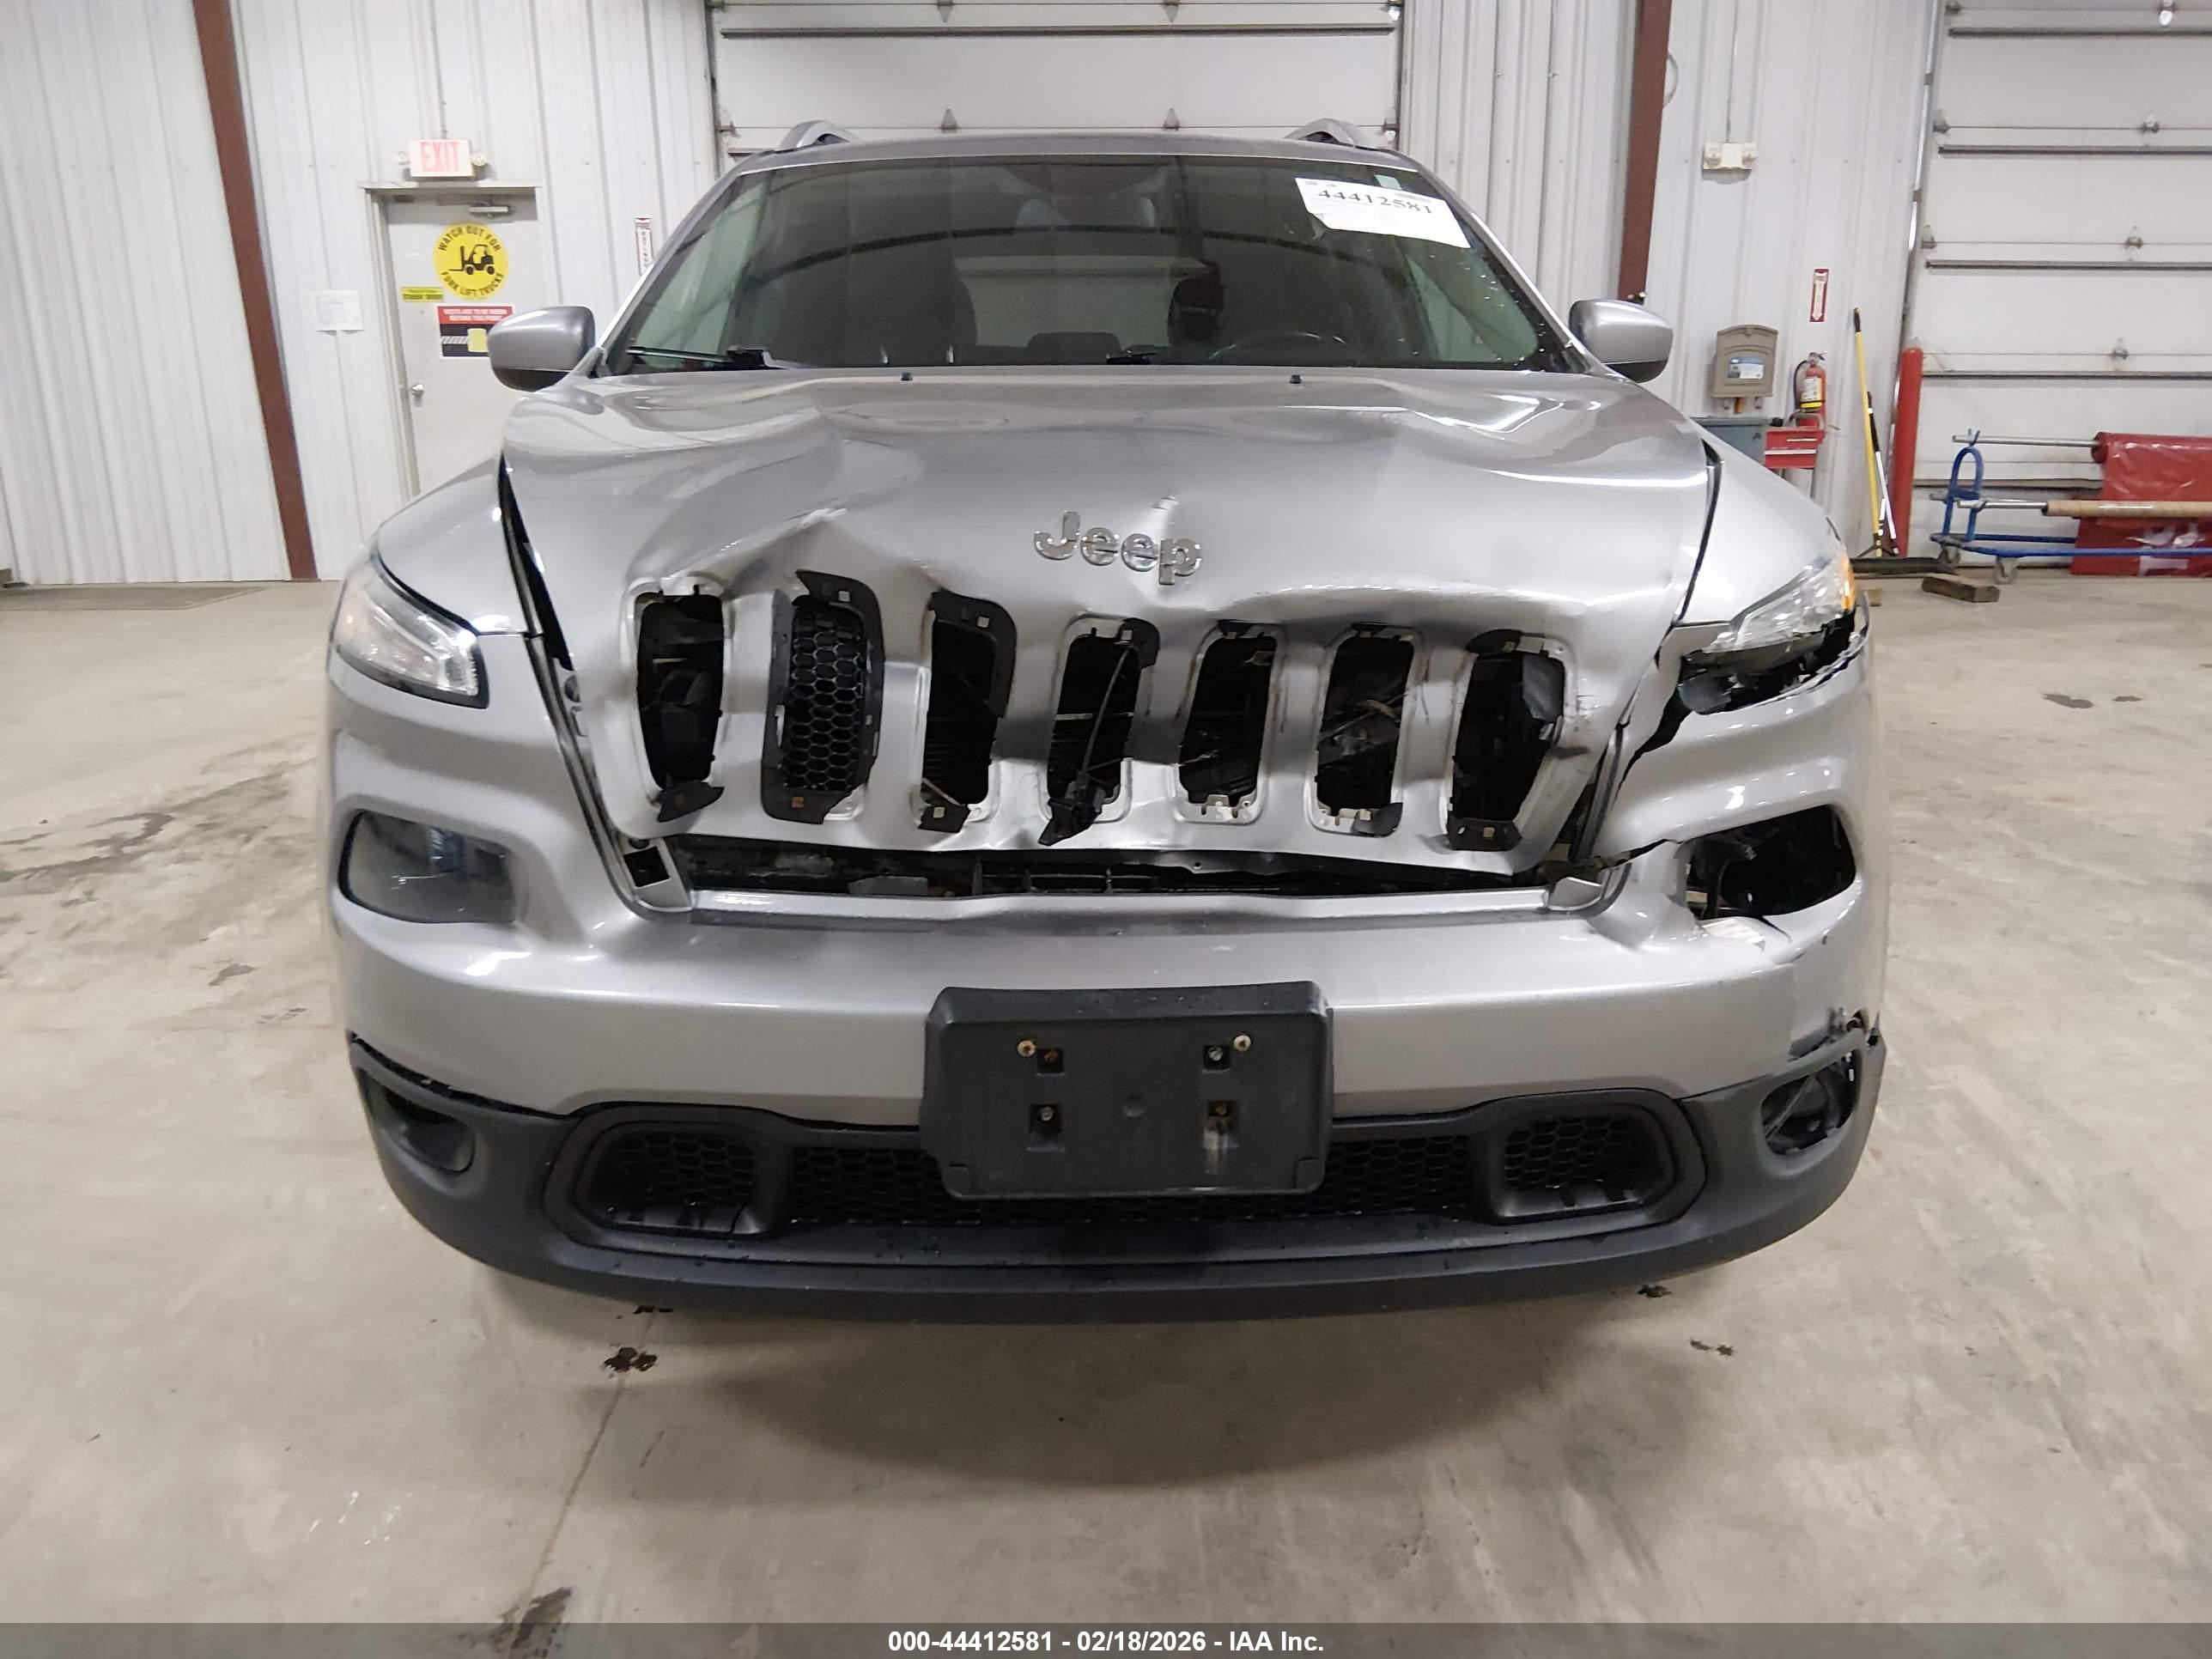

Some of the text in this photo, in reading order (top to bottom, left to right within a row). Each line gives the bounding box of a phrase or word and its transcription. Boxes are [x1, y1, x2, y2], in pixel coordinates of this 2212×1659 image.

[421, 142, 459, 172] EXIT
[1318, 190, 1432, 214] 44412581
[438, 225, 501, 252] WATCH OUT FOR
[441, 271, 504, 296] FORK LIFT TRUCKS
[1033, 509, 1203, 586] Jeep
